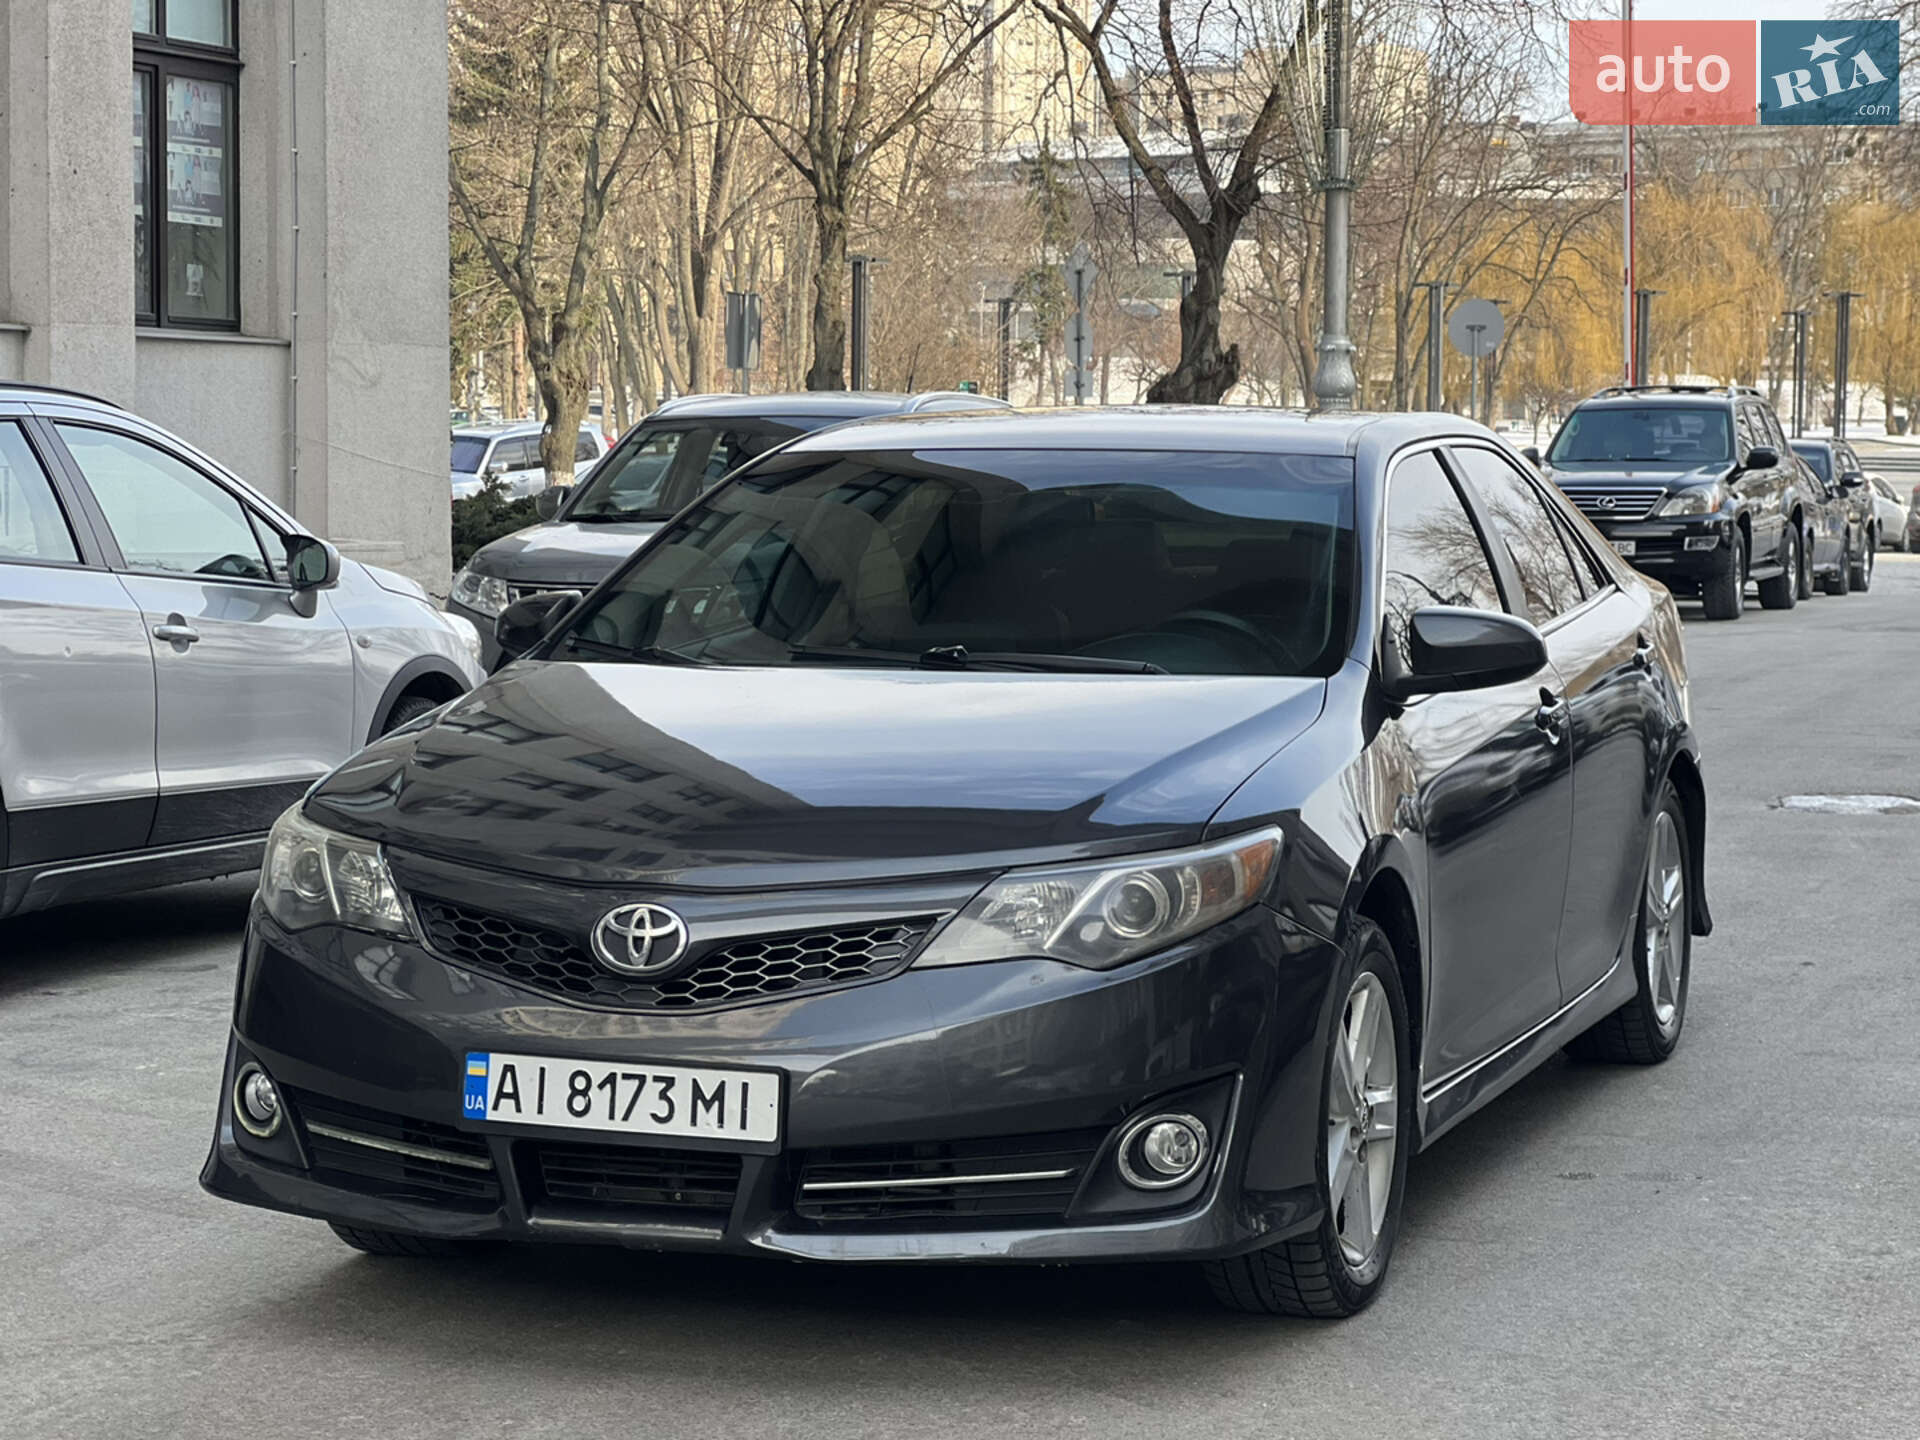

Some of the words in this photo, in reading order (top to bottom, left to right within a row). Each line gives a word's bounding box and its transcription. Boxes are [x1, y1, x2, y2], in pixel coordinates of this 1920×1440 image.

[464, 1094, 485, 1111] UA
[491, 1063, 546, 1116] AI
[566, 1069, 676, 1125] 8173
[690, 1077, 749, 1131] MI
